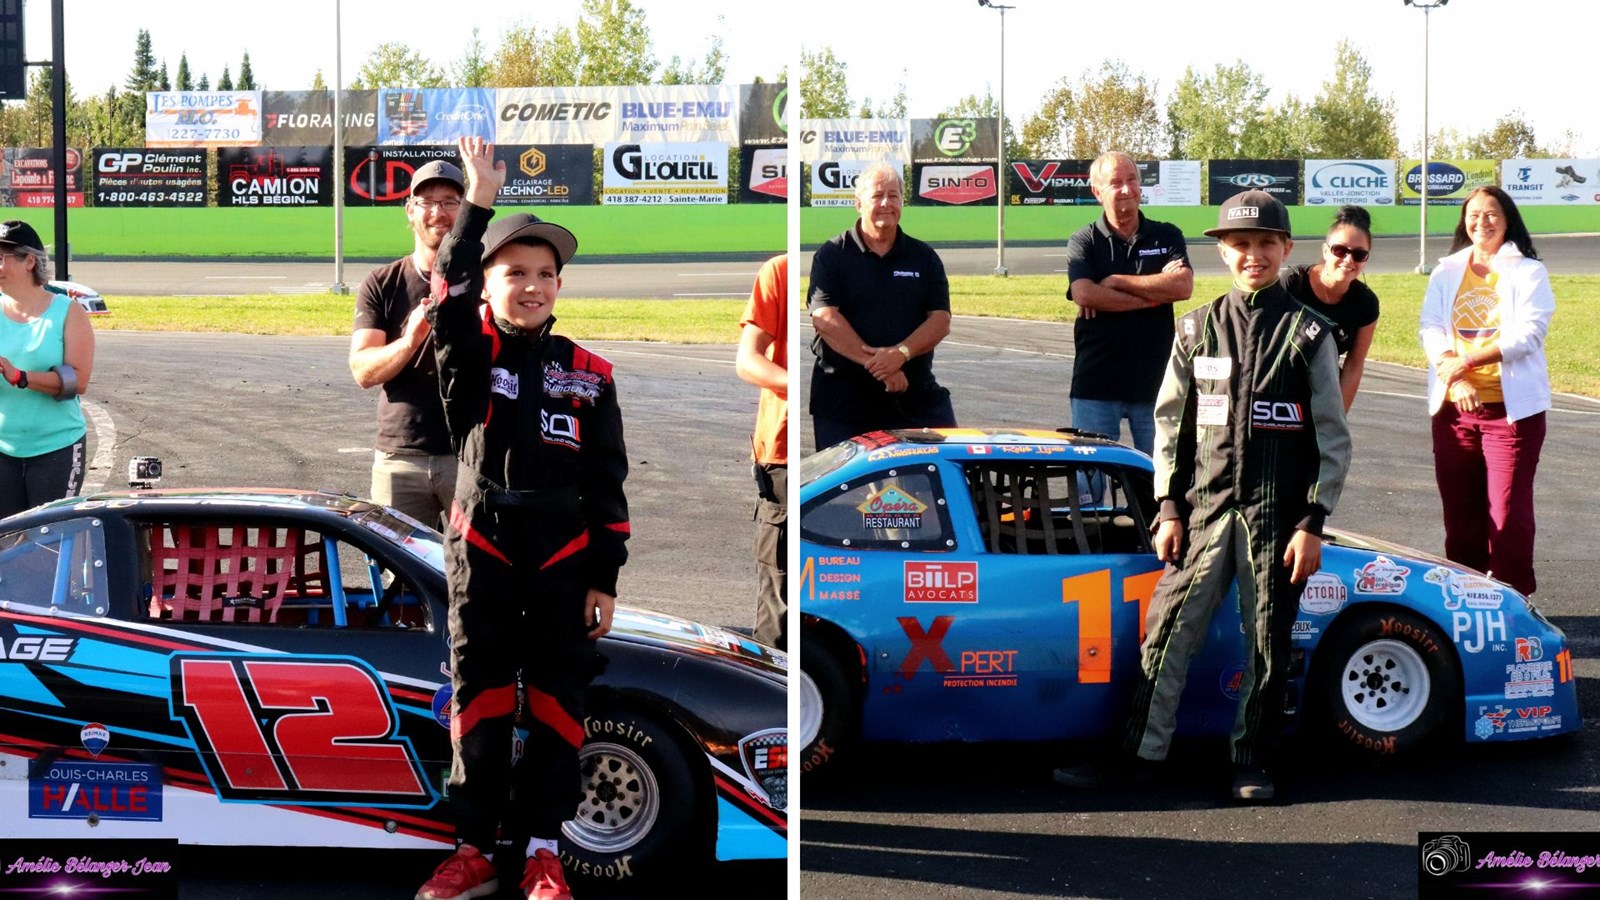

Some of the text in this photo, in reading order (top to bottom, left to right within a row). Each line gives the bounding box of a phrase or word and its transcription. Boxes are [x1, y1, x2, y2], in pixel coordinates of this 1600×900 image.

[153, 94, 233, 113] LES POMPES
[500, 102, 612, 121] COMETIC
[622, 102, 731, 119] BLUE-EMU
[277, 113, 376, 128] FLORAING
[622, 121, 679, 132] Maximum
[171, 128, 241, 139] 227-7730
[824, 130, 904, 143] BLUE-EMU
[382, 150, 457, 158] INSTALLATIONS
[824, 145, 867, 153] Maximum
[145, 153, 202, 163] Clément
[14, 159, 48, 169] EXCAVATIONS
[142, 164, 202, 173] Poulin inc.
[12, 170, 41, 185] Lapointe
[99, 177, 127, 186] Pièces
[166, 178, 202, 188] usagées
[512, 178, 553, 186] ÉCLAIRAGE
[928, 178, 988, 188] SINTO
[1407, 173, 1464, 184] BRSSARD
[232, 178, 319, 195] CAMION
[27, 196, 41, 204] 418
[98, 192, 203, 202] 1-800-463-4522
[232, 196, 259, 204] HLS
[669, 195, 723, 203] Sainte-Marie
[1230, 207, 1258, 218] VANS
[870, 496, 919, 514] Opéra
[866, 517, 921, 528] RESTAURANT
[819, 556, 861, 566] BUREAU
[819, 573, 861, 583] DESIGN
[819, 590, 861, 600] MASSÉ
[908, 590, 974, 599] AVOCATS
[1302, 586, 1347, 600] ICTORIA
[1452, 610, 1507, 653] PJH
[1492, 643, 1508, 652] INC.
[1556, 648, 1573, 684] 11
[943, 678, 1018, 687] PROTECTION INCENDIE
[1516, 705, 1552, 719] VIP
[181, 659, 427, 795] 12
[44, 769, 149, 782] OUIS-CHARLES
